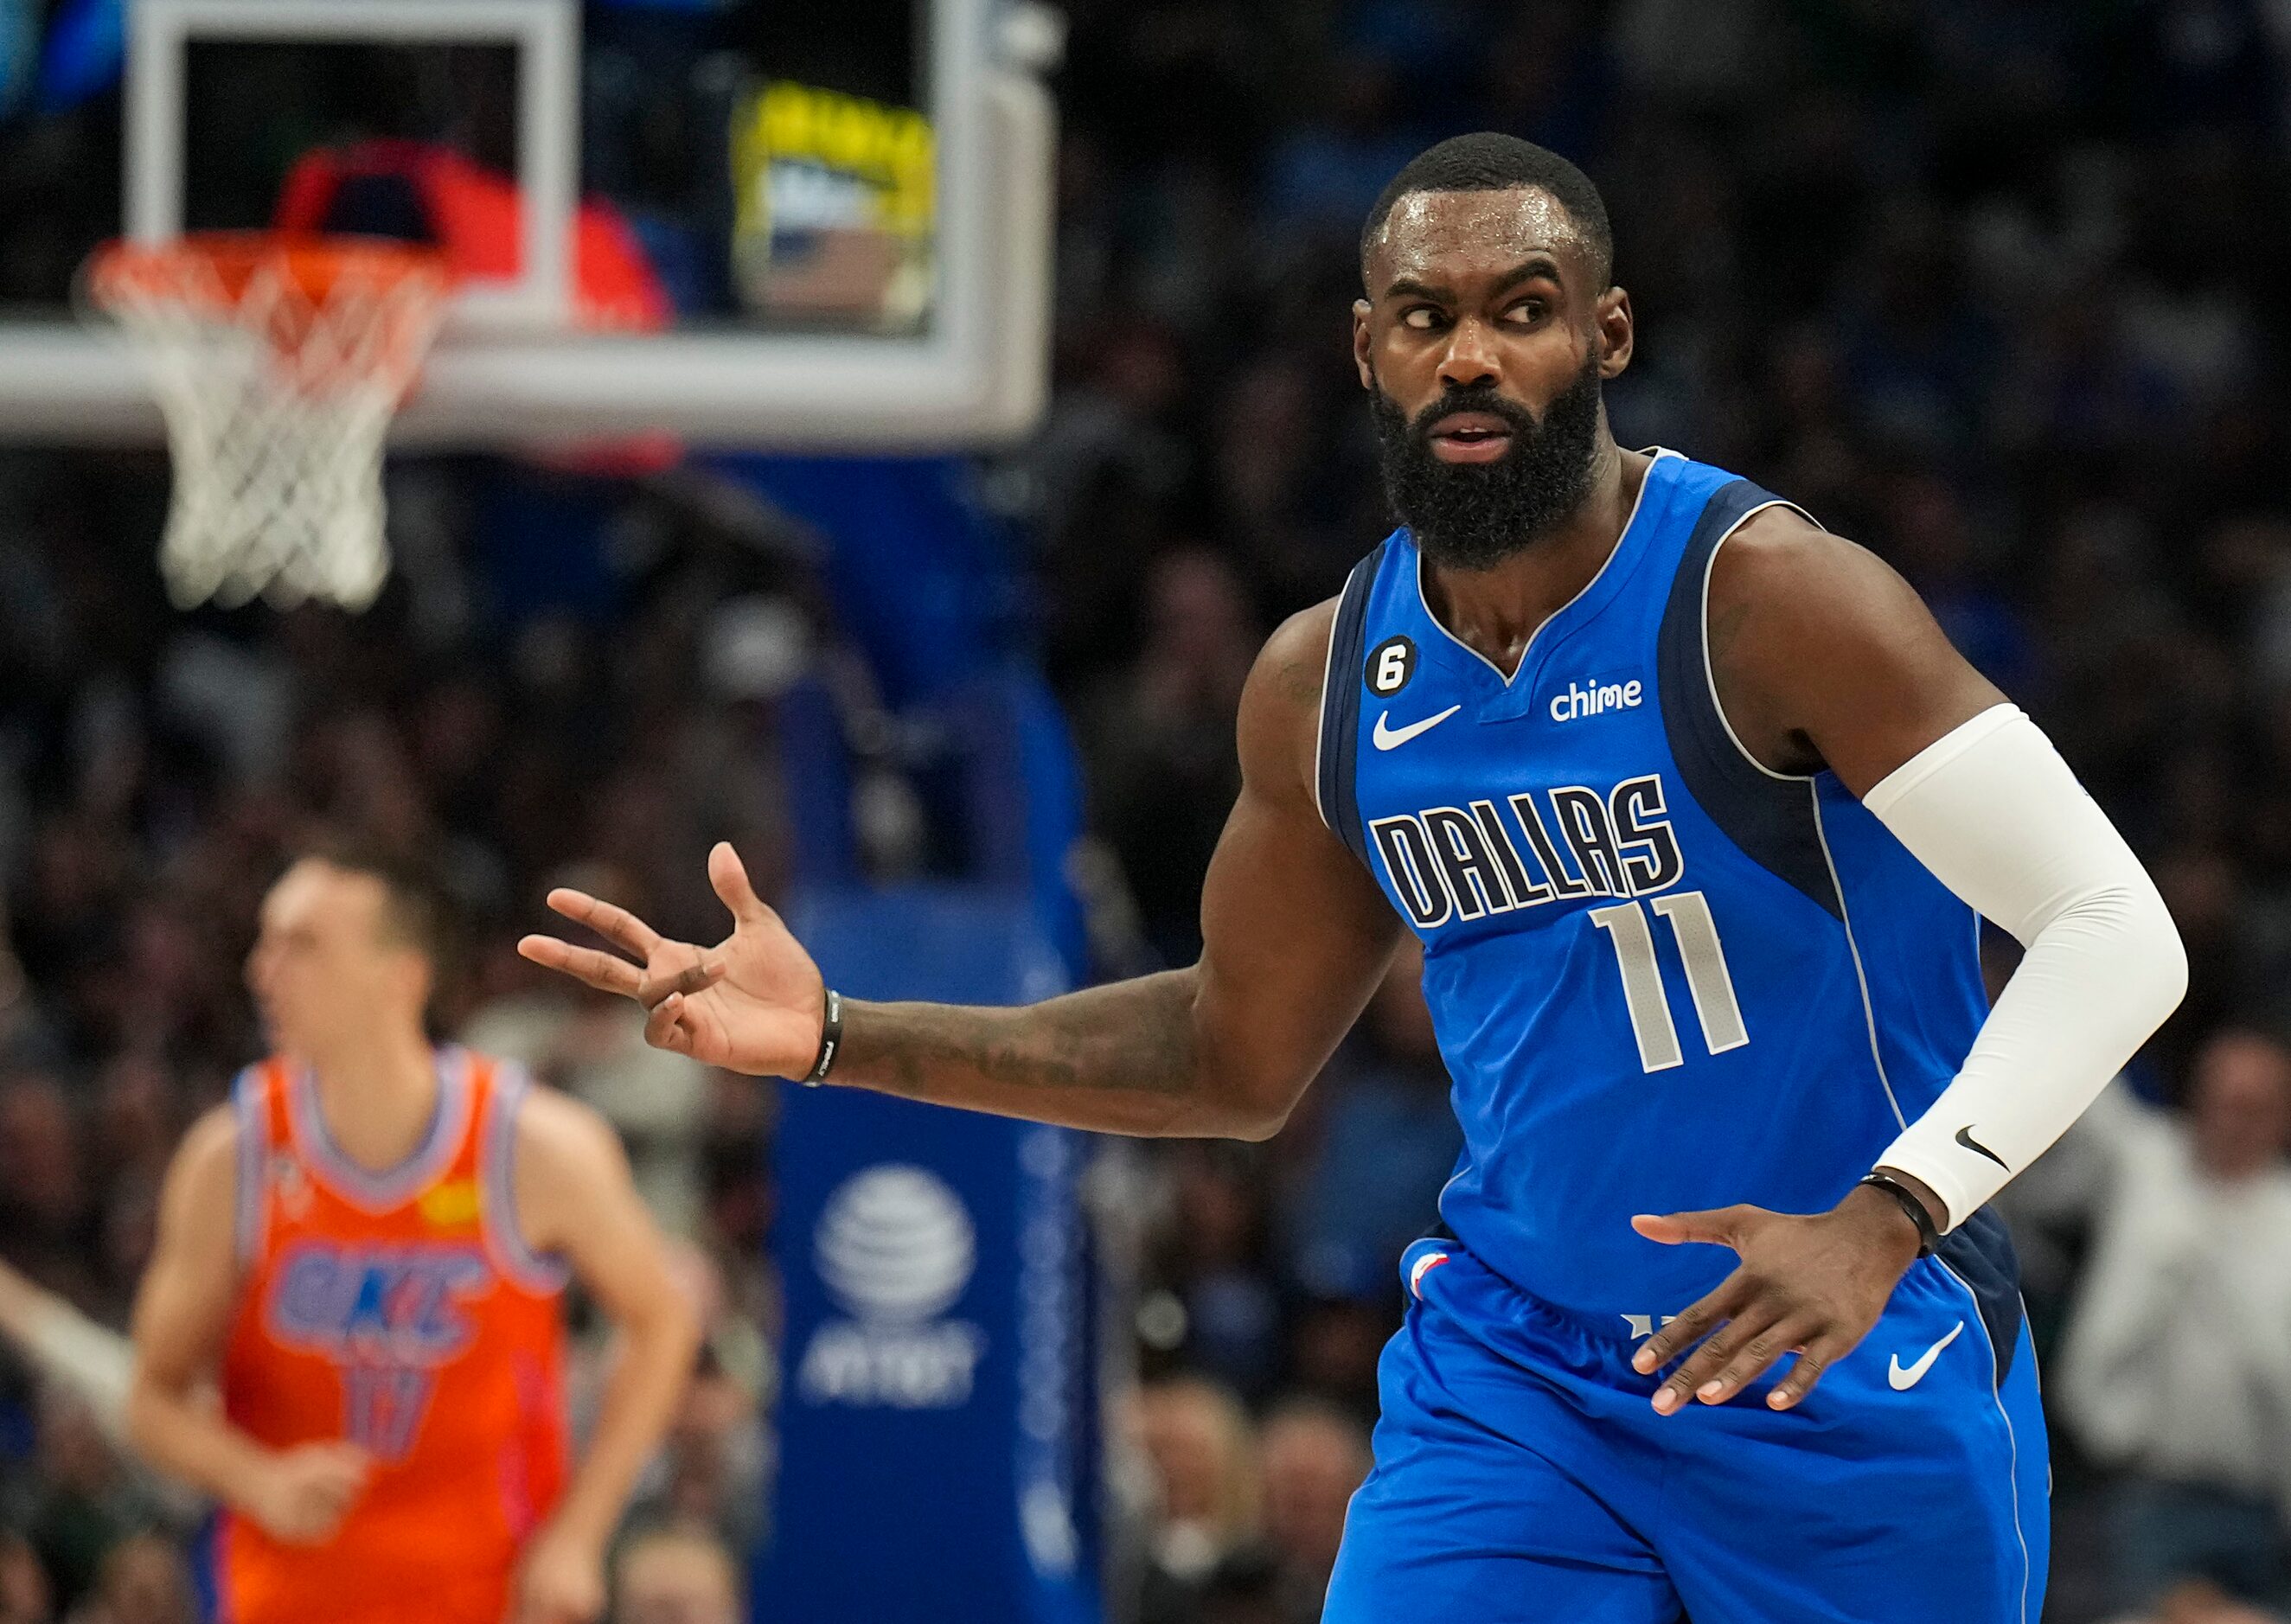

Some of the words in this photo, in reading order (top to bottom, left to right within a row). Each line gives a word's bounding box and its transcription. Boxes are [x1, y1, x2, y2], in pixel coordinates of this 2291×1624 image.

[1376, 644, 1406, 691] 6
[1550, 679, 1642, 722] chime
[1368, 774, 1684, 928] DALLAS
[1588, 891, 1750, 1073] 11
